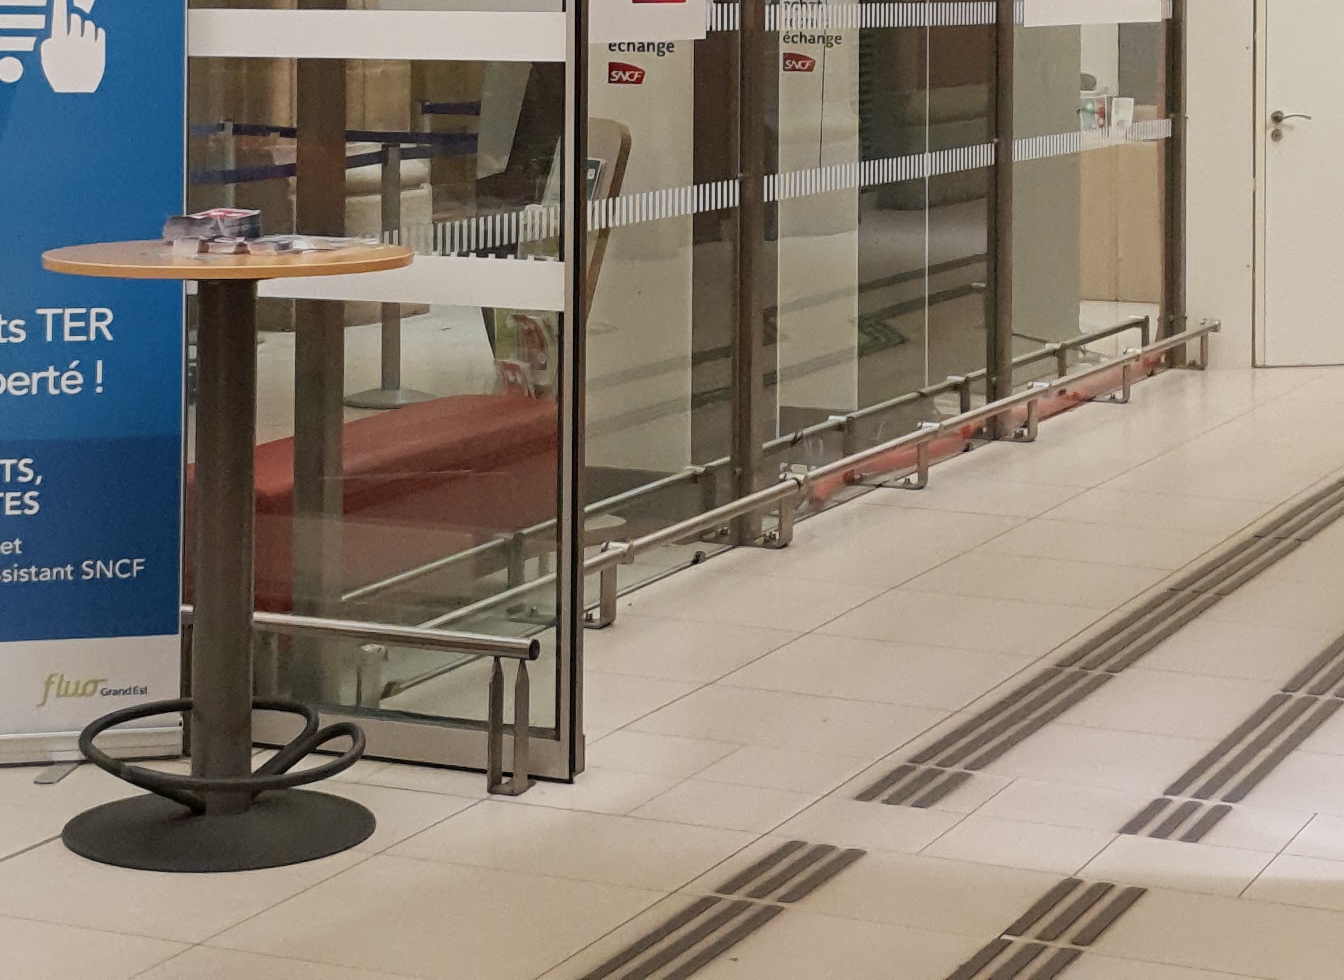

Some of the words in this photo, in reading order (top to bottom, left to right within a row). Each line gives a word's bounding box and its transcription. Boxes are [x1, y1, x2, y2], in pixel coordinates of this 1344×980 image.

[782, 31, 842, 48] échange
[784, 60, 812, 70] SNCF
[610, 70, 643, 82] SNCF
[36, 307, 114, 342] TER
[96, 360, 104, 394] !
[81, 559, 146, 580] SNCF
